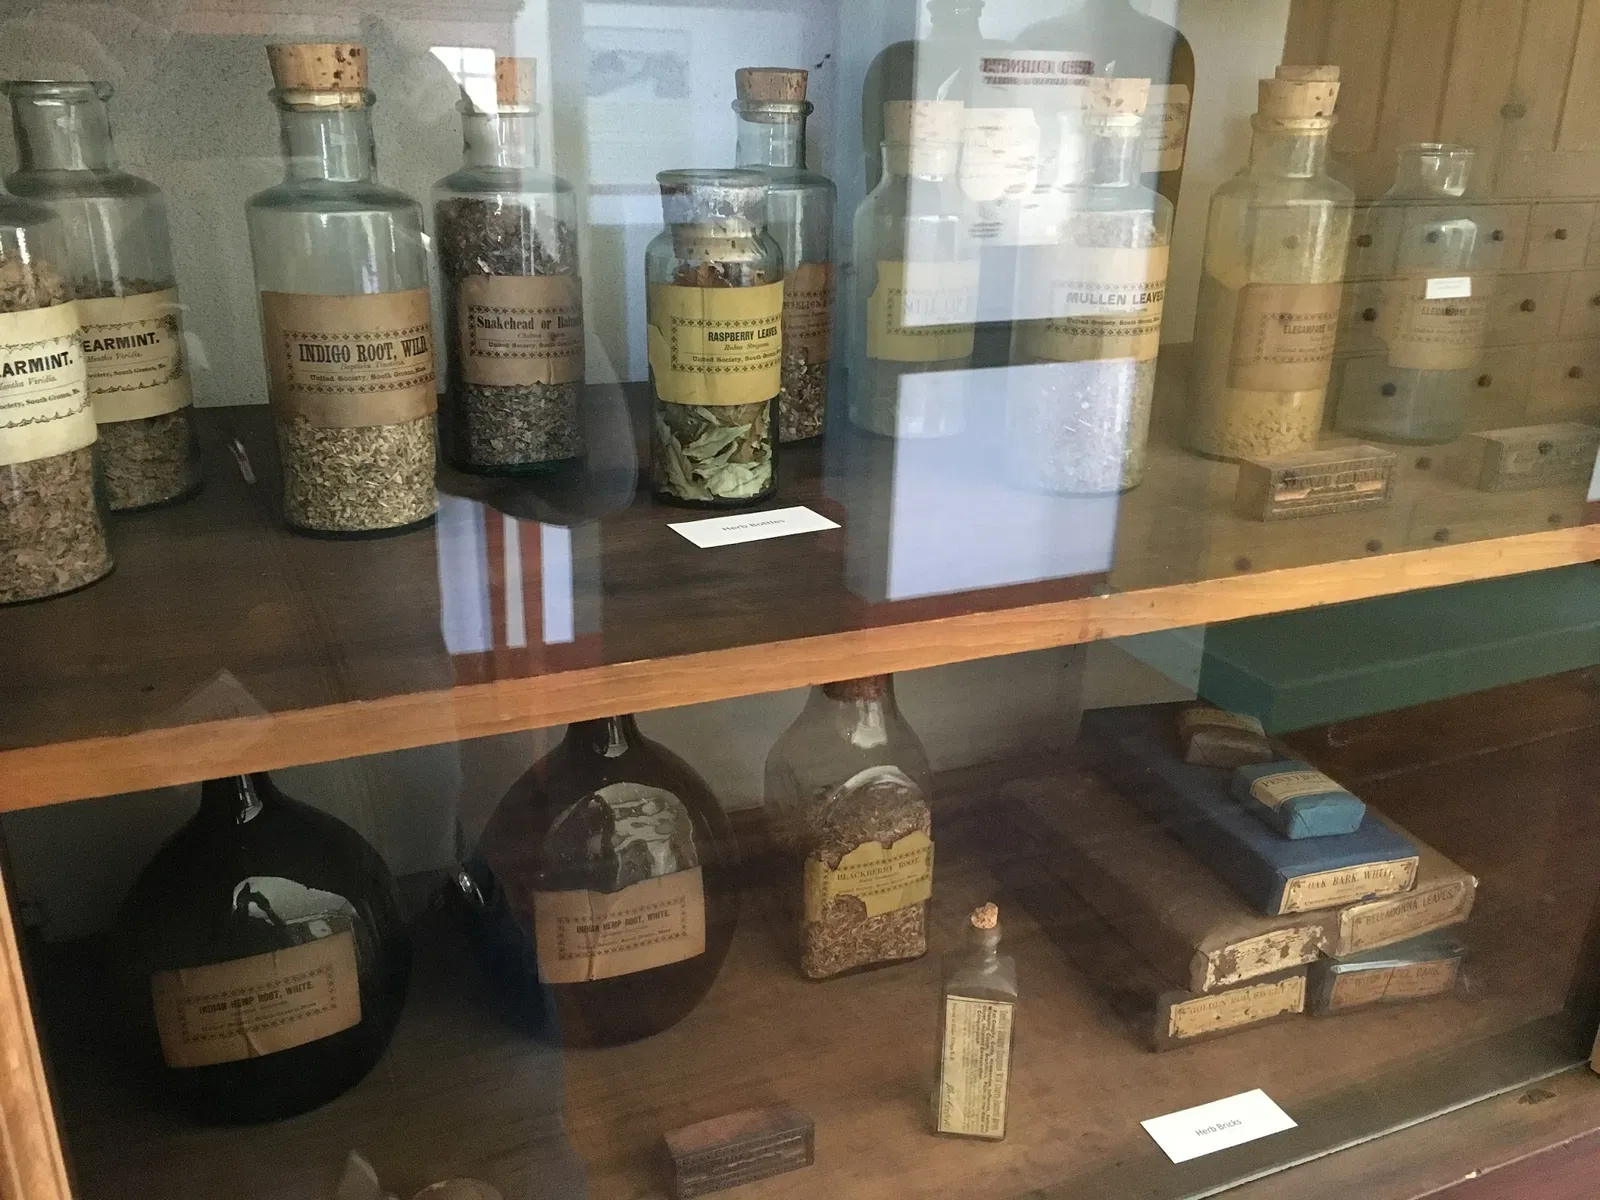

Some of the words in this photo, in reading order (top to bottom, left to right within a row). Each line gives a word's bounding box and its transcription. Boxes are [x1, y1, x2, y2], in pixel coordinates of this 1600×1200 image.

[1066, 291, 1127, 305] MULLEN
[1132, 289, 1164, 304] LEAVES
[477, 315, 534, 331] Snakehead
[541, 320, 552, 330] or
[708, 331, 754, 342] RASPBERRY
[757, 326, 778, 339] LEAVES
[82, 332, 160, 353] EARMINT.
[299, 343, 350, 363] INDIGO
[356, 342, 397, 362] ROOT,
[692, 355, 714, 363] United
[0, 351, 74, 378] ARMINT.
[0, 401, 25, 410] ociety,
[722, 523, 748, 532] Herb
[1195, 1124, 1217, 1137] Herb
[1216, 1118, 1242, 1131] Bricks
